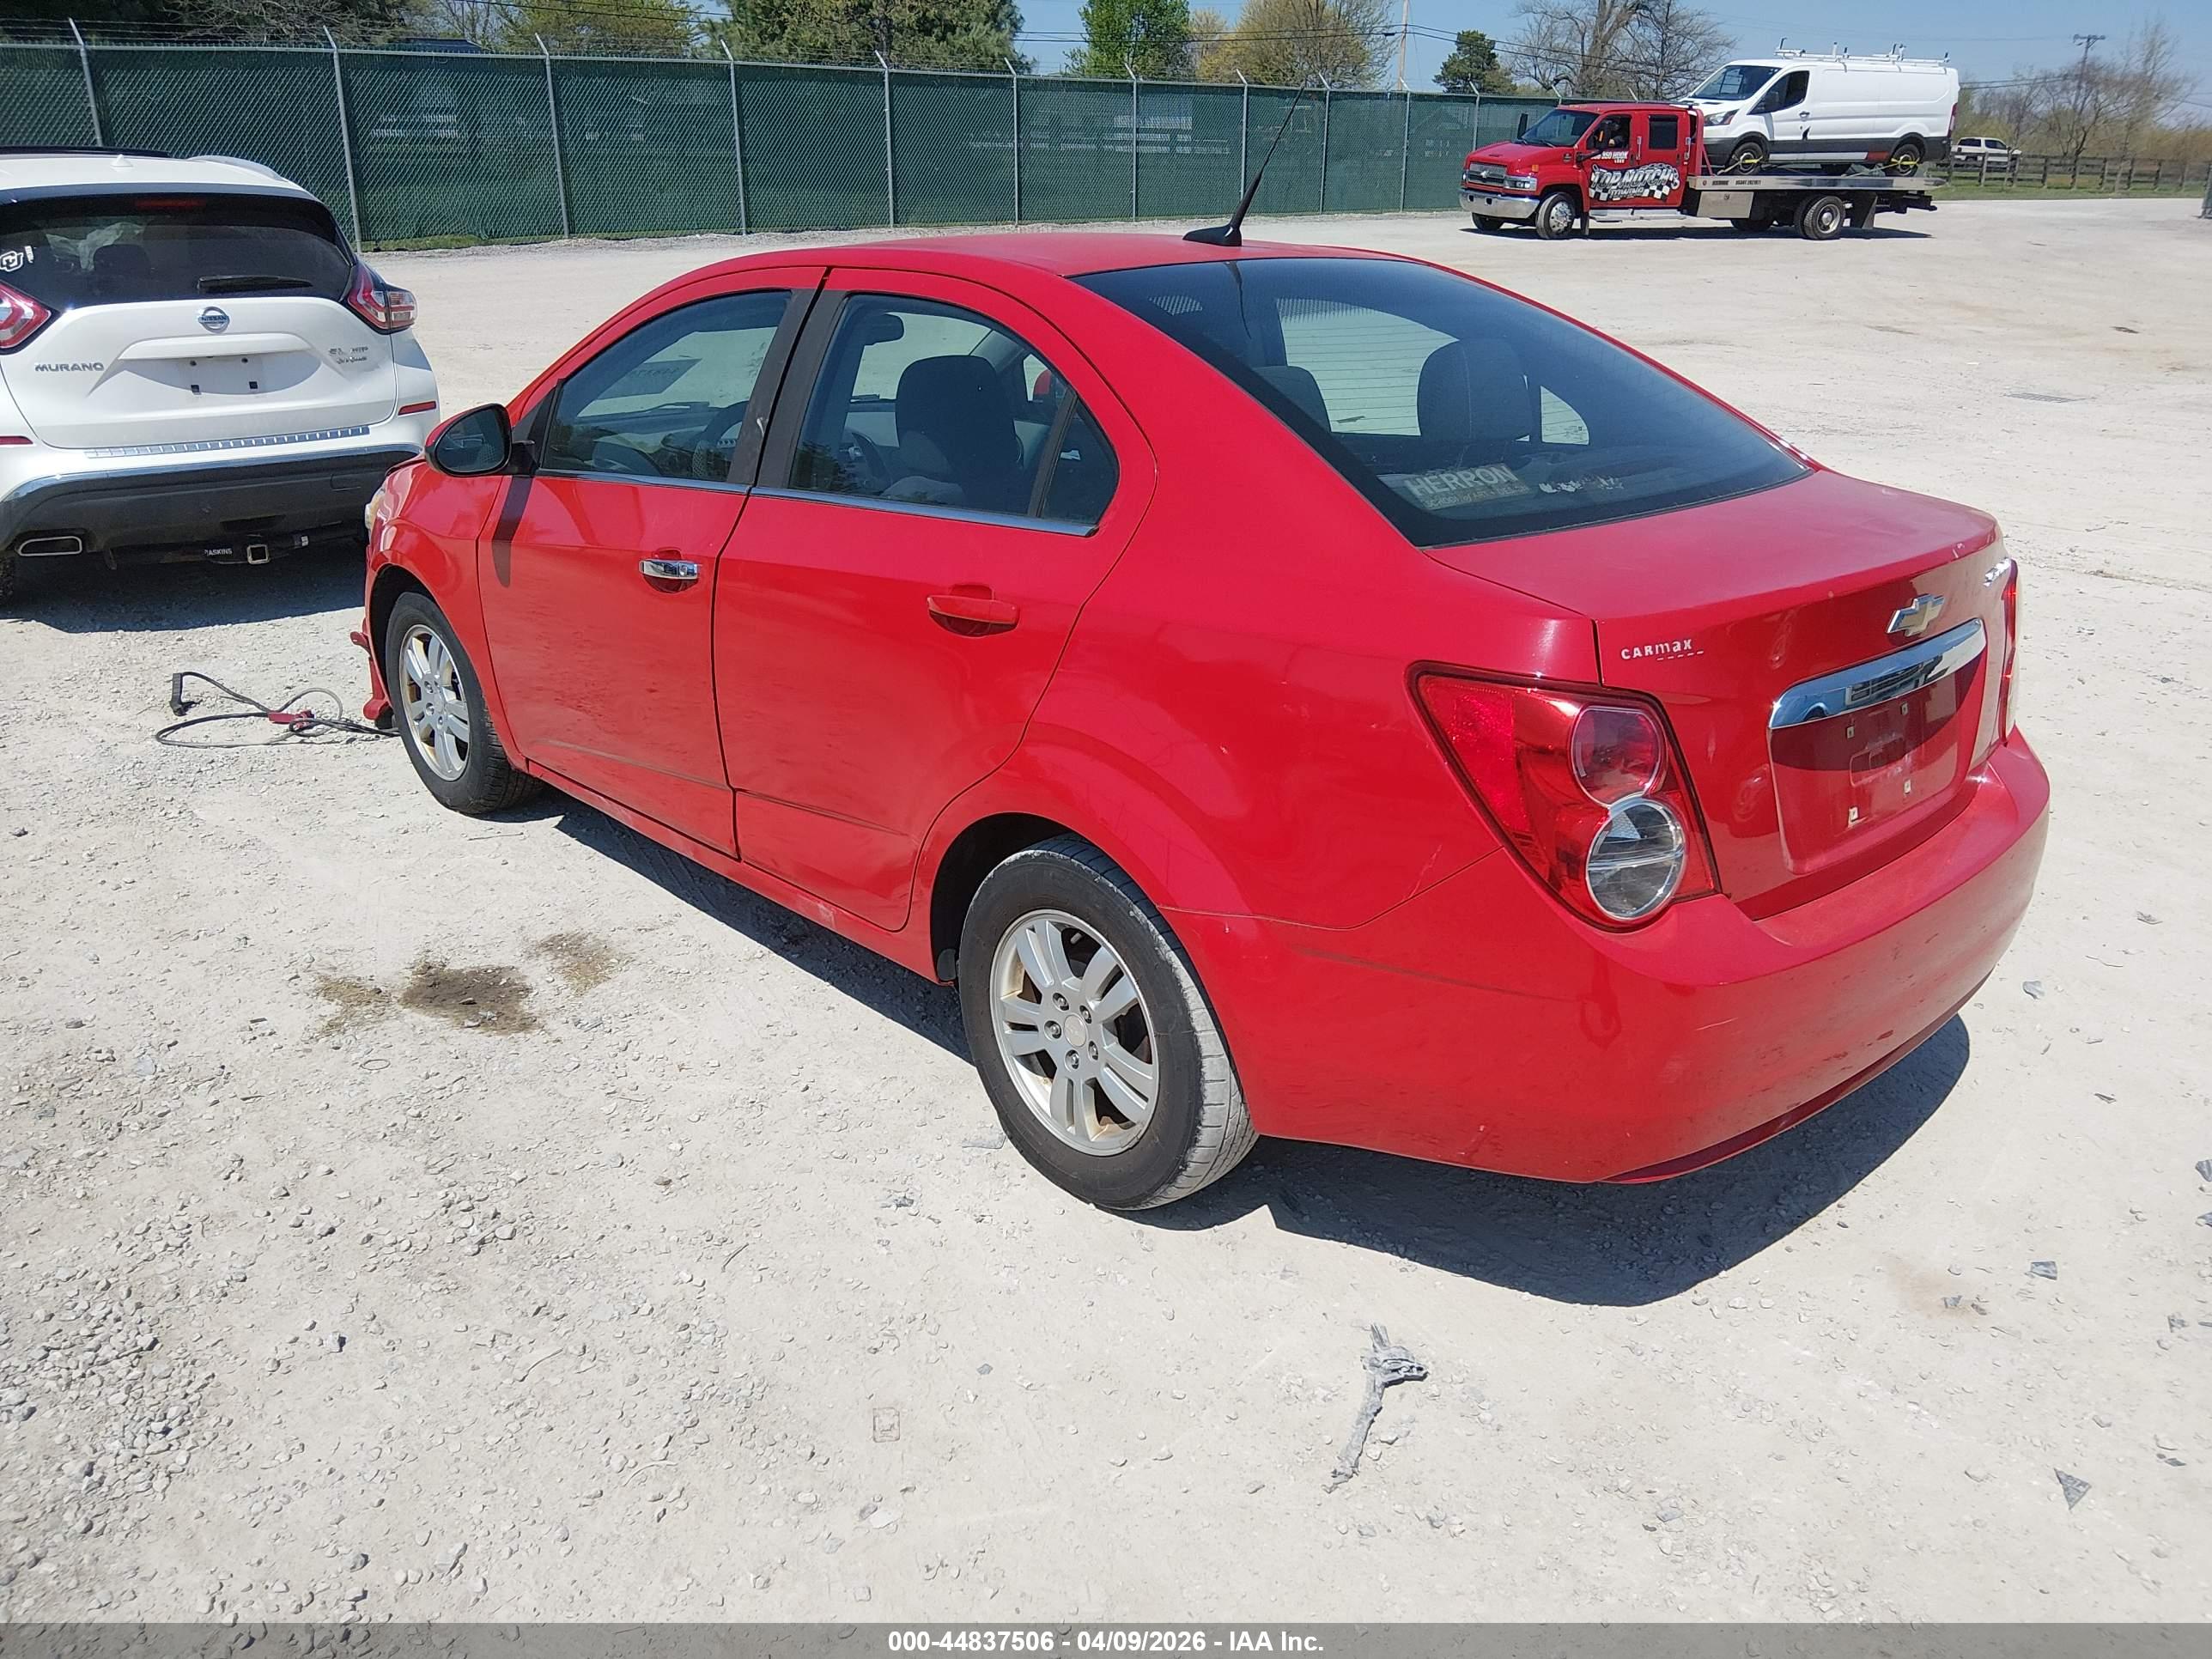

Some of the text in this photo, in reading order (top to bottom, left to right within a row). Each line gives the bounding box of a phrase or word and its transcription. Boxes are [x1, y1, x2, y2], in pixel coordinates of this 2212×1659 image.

[1620, 168, 1673, 187] NOTCH
[34, 362, 104, 372] MURANO
[1404, 465, 1519, 496] HERRON
